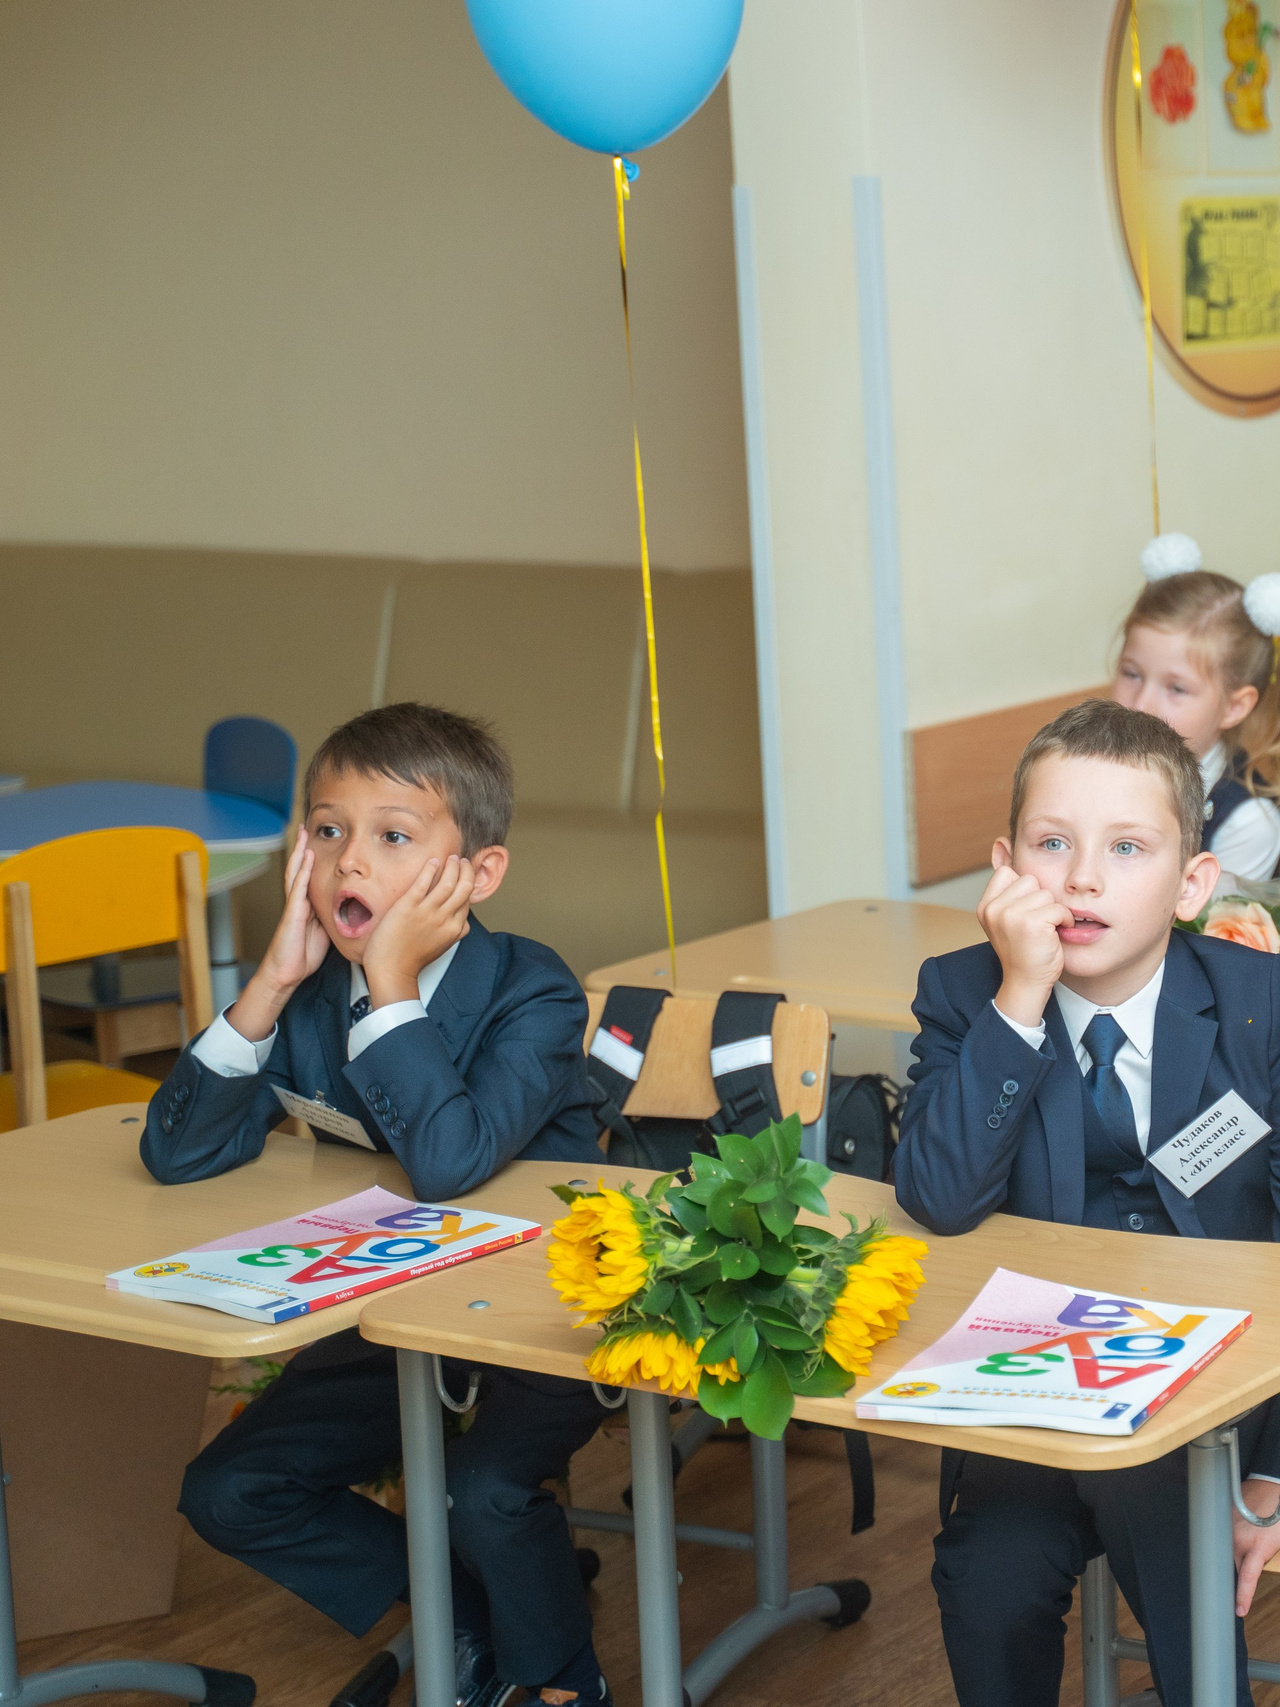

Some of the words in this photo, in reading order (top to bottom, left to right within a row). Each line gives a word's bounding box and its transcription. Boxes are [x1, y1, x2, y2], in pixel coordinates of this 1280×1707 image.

[1171, 1110, 1223, 1149] Чудаков
[1179, 1115, 1239, 1167] Александр
[1180, 1175, 1188, 1184] 1
[1190, 1157, 1213, 1177] «И»
[1214, 1128, 1247, 1158] класс
[295, 1218, 361, 1235] Первый
[335, 1290, 355, 1300] Азбука
[410, 1261, 435, 1276] Первый
[434, 1259, 445, 1268] год
[445, 1251, 473, 1264] обучения
[967, 1323, 1061, 1338] Первый
[975, 1316, 1042, 1329] обучения
